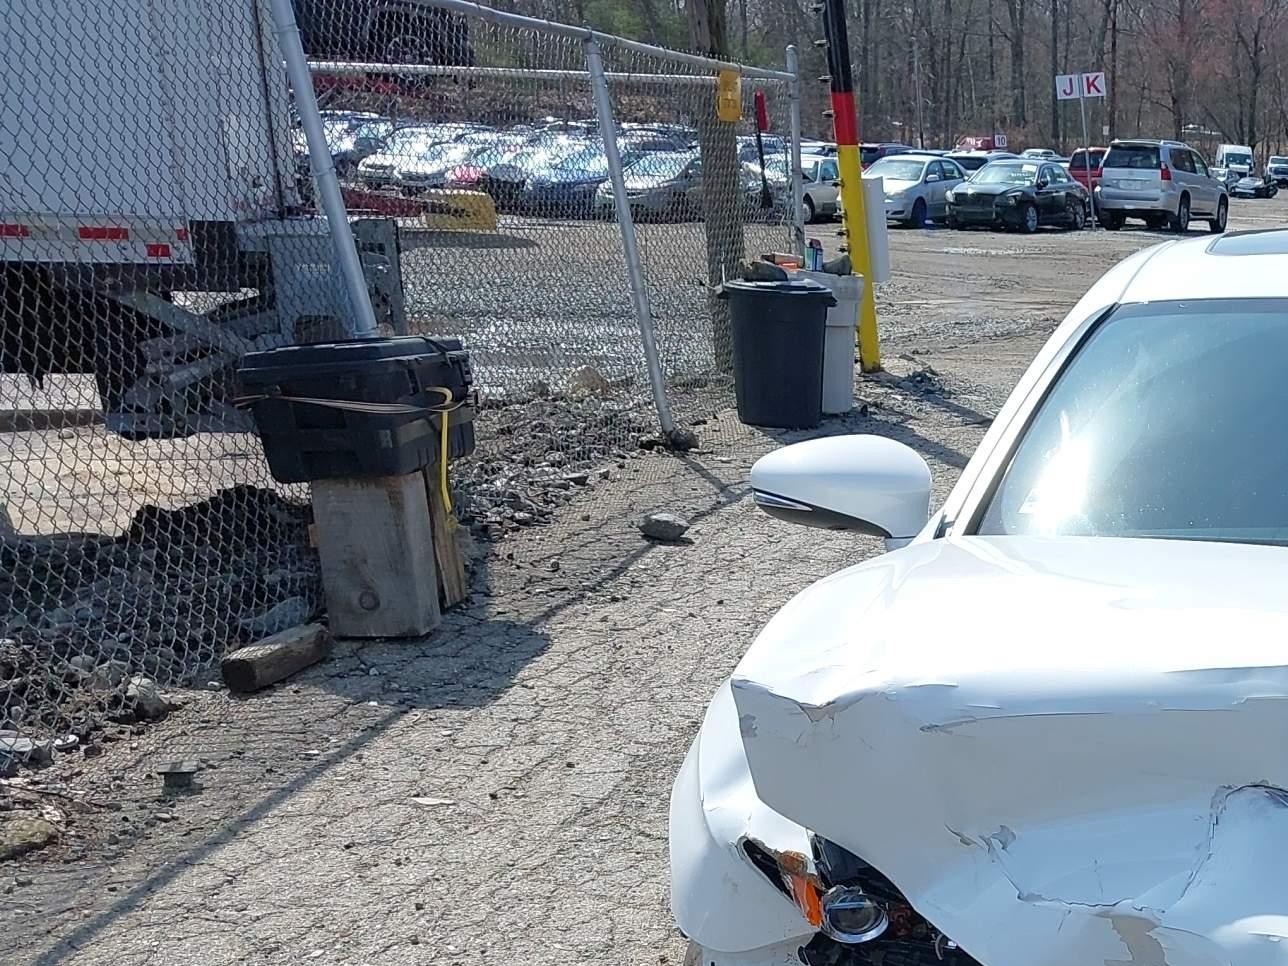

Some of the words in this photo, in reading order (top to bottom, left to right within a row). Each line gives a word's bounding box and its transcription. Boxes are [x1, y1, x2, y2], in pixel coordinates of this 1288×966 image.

[1062, 77, 1074, 96] J
[1085, 74, 1102, 95] K
[997, 135, 1006, 146] 10
